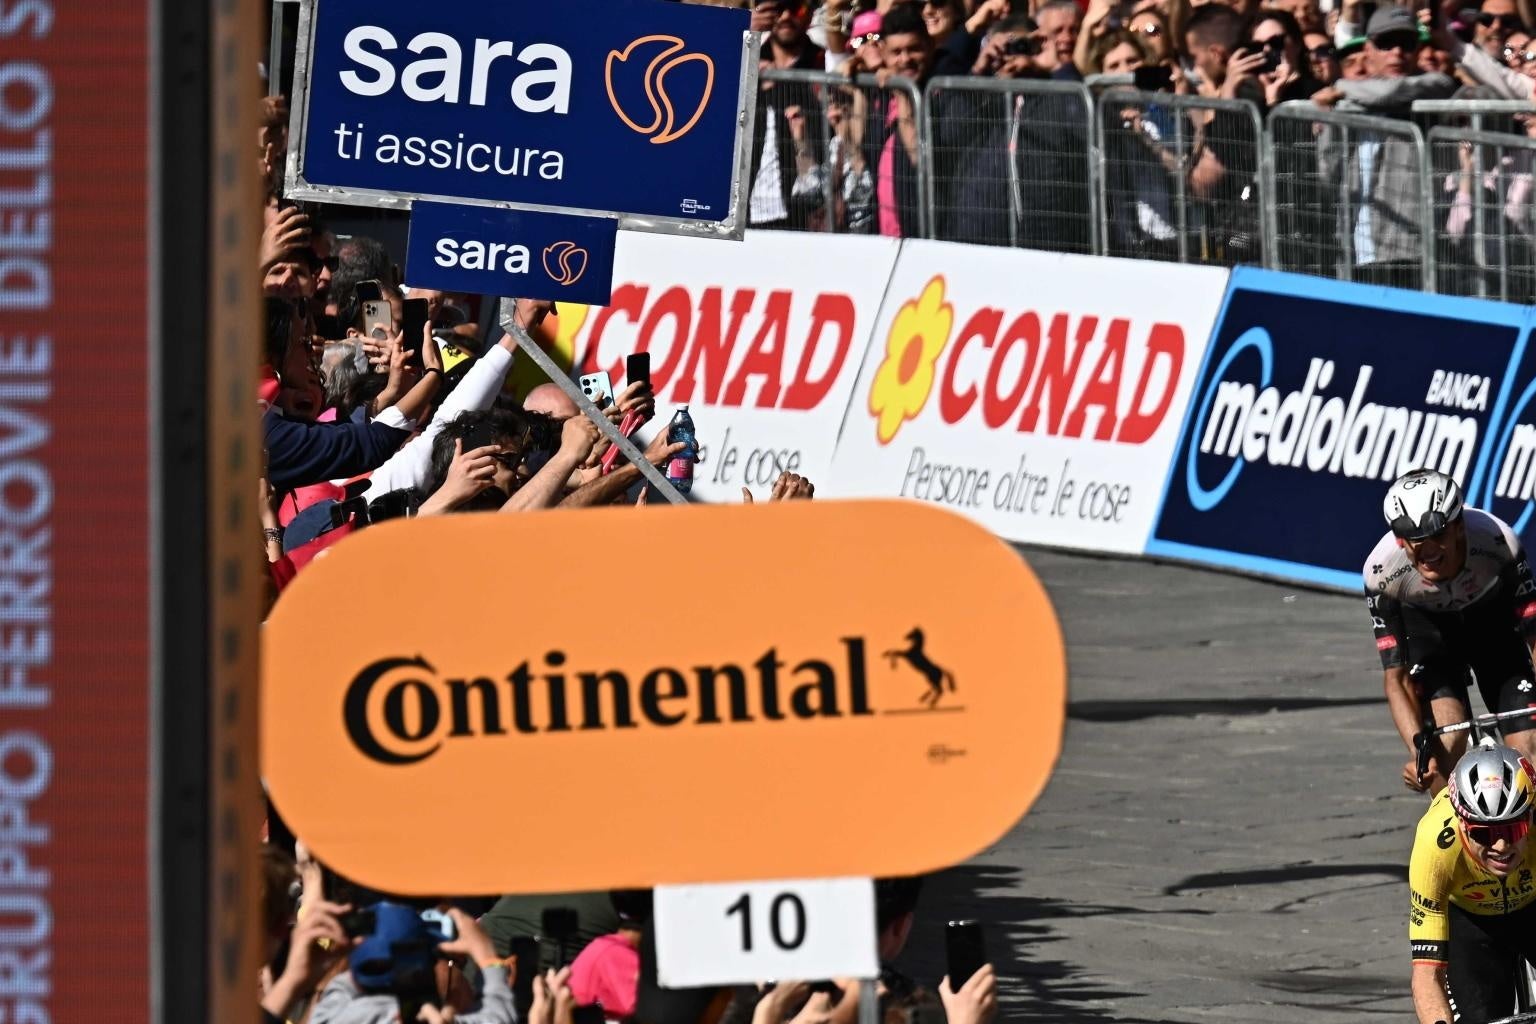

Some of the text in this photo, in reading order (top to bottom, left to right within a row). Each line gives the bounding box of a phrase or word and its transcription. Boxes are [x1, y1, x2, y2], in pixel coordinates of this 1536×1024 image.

[338, 25, 574, 116] sara
[0, 62, 53, 310] DELLO
[334, 121, 565, 181] ti assicura
[433, 236, 530, 275] sara
[581, 281, 856, 412] CONAD
[938, 306, 1186, 445] CONAD
[1425, 368, 1490, 412] BANCA
[1200, 355, 1478, 490] mediolanum
[0, 334, 53, 706] FERROVIE
[899, 446, 1131, 524] Persone oltre le cose
[341, 636, 875, 767] Continental
[725, 891, 809, 955] 10
